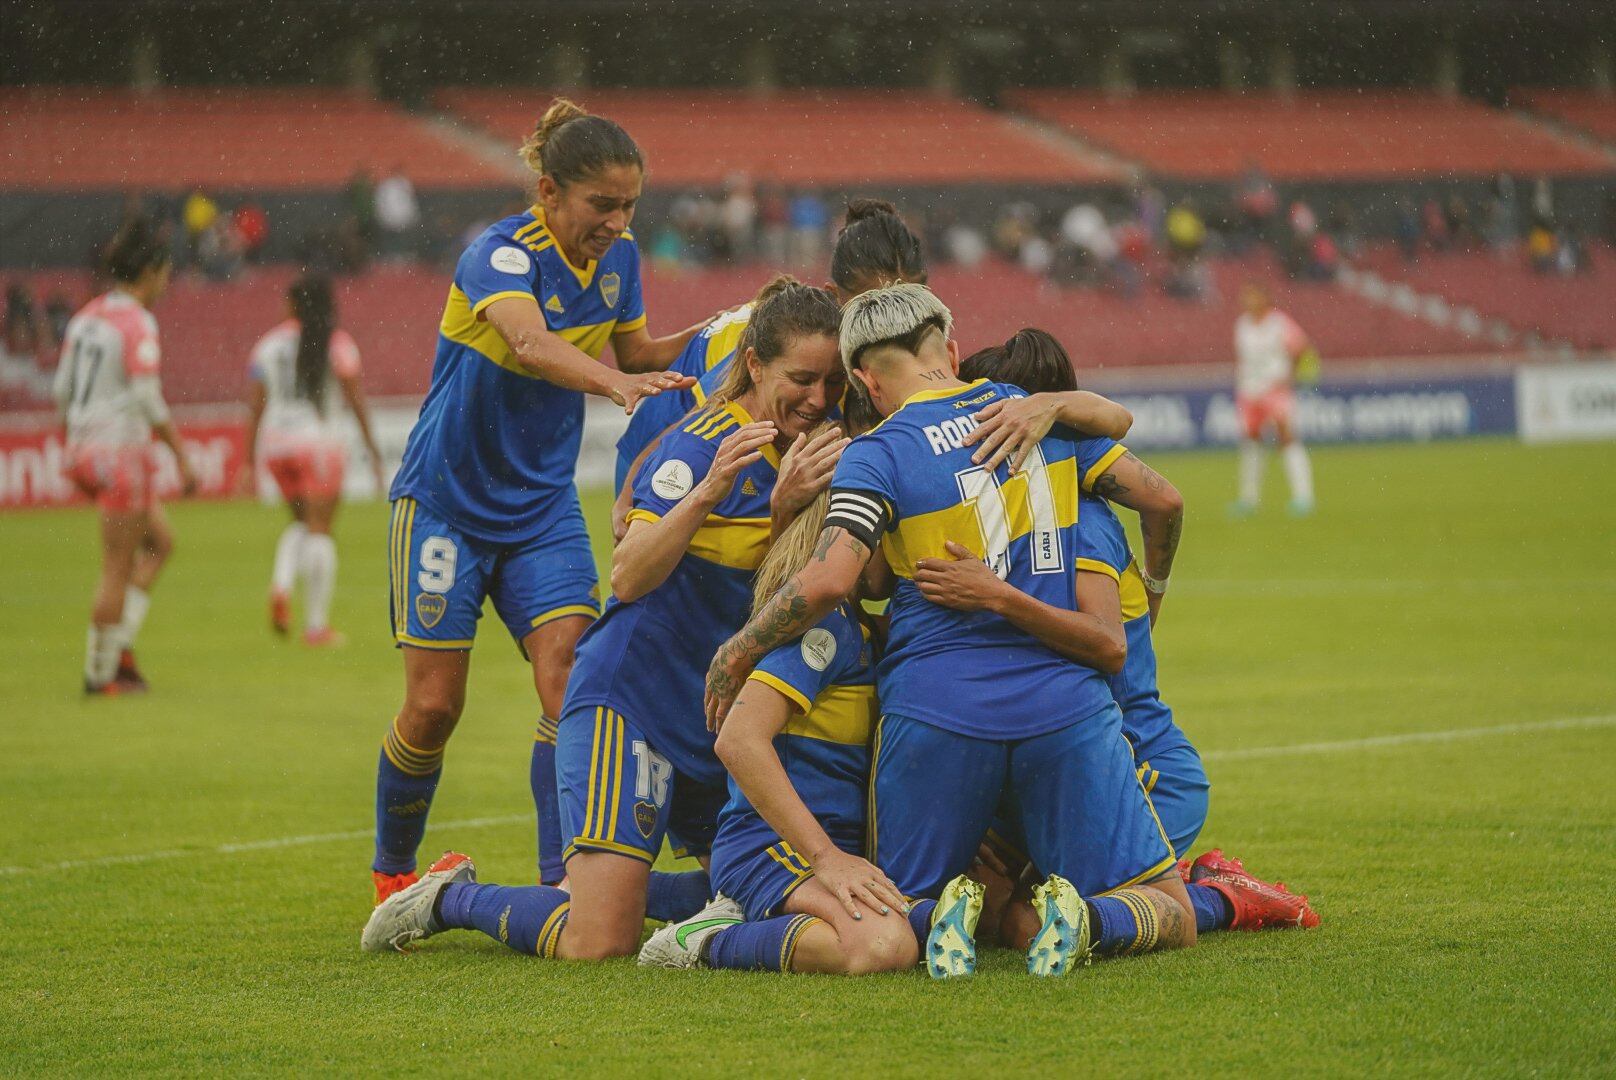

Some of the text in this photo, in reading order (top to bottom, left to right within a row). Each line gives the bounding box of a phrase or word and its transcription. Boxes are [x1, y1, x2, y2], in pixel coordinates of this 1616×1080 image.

[417, 535, 458, 593] 9
[1043, 531, 1051, 560] CABJ
[632, 740, 673, 808] 18
